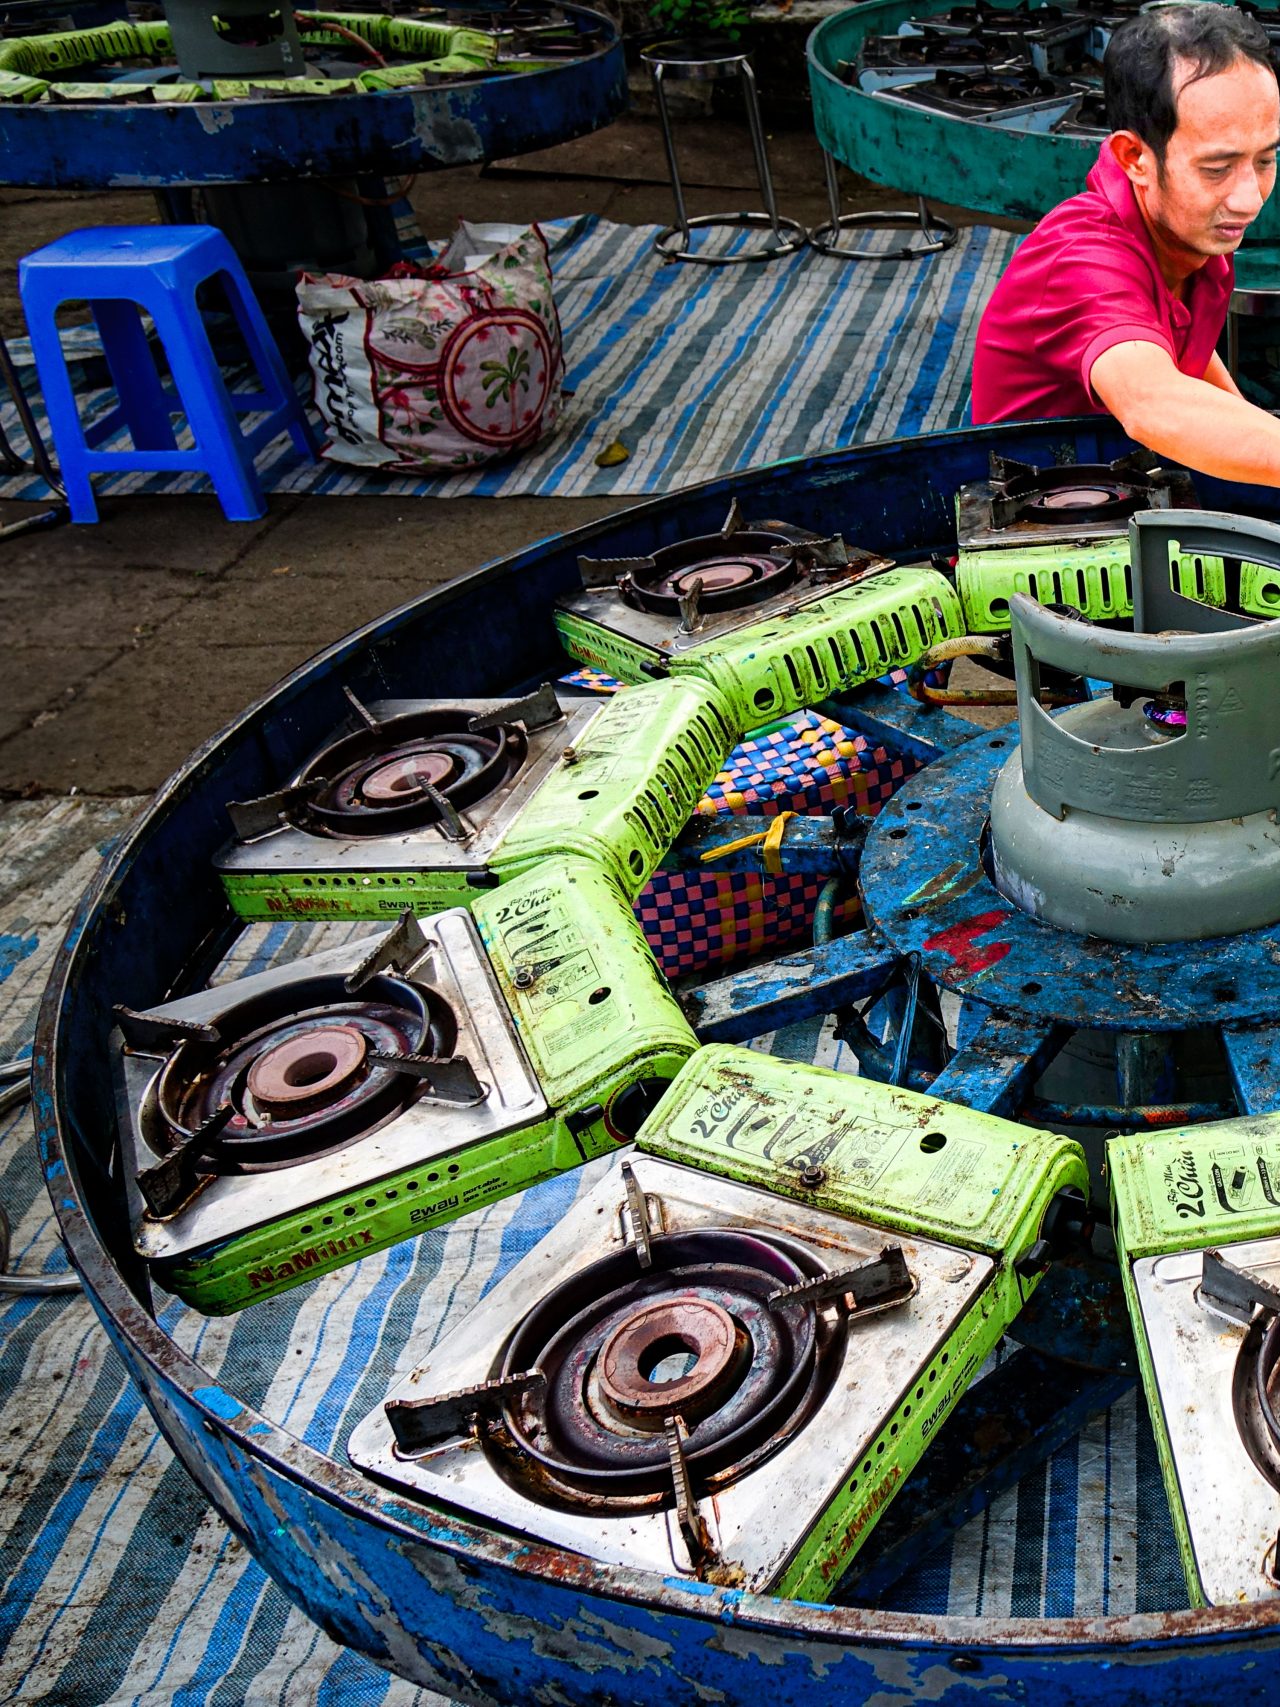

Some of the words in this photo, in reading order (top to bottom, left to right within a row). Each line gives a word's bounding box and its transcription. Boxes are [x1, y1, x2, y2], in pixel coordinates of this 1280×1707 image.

[496, 907, 514, 924] 2
[690, 1119, 720, 1139] 2
[1172, 1150, 1204, 1199] Chiều
[462, 1176, 501, 1198] portable
[483, 1179, 509, 1195] stove
[409, 1194, 459, 1223] 2way
[1175, 1200, 1206, 1219] 2
[247, 1227, 375, 1289] NaMilux
[921, 1389, 953, 1437] 2way
